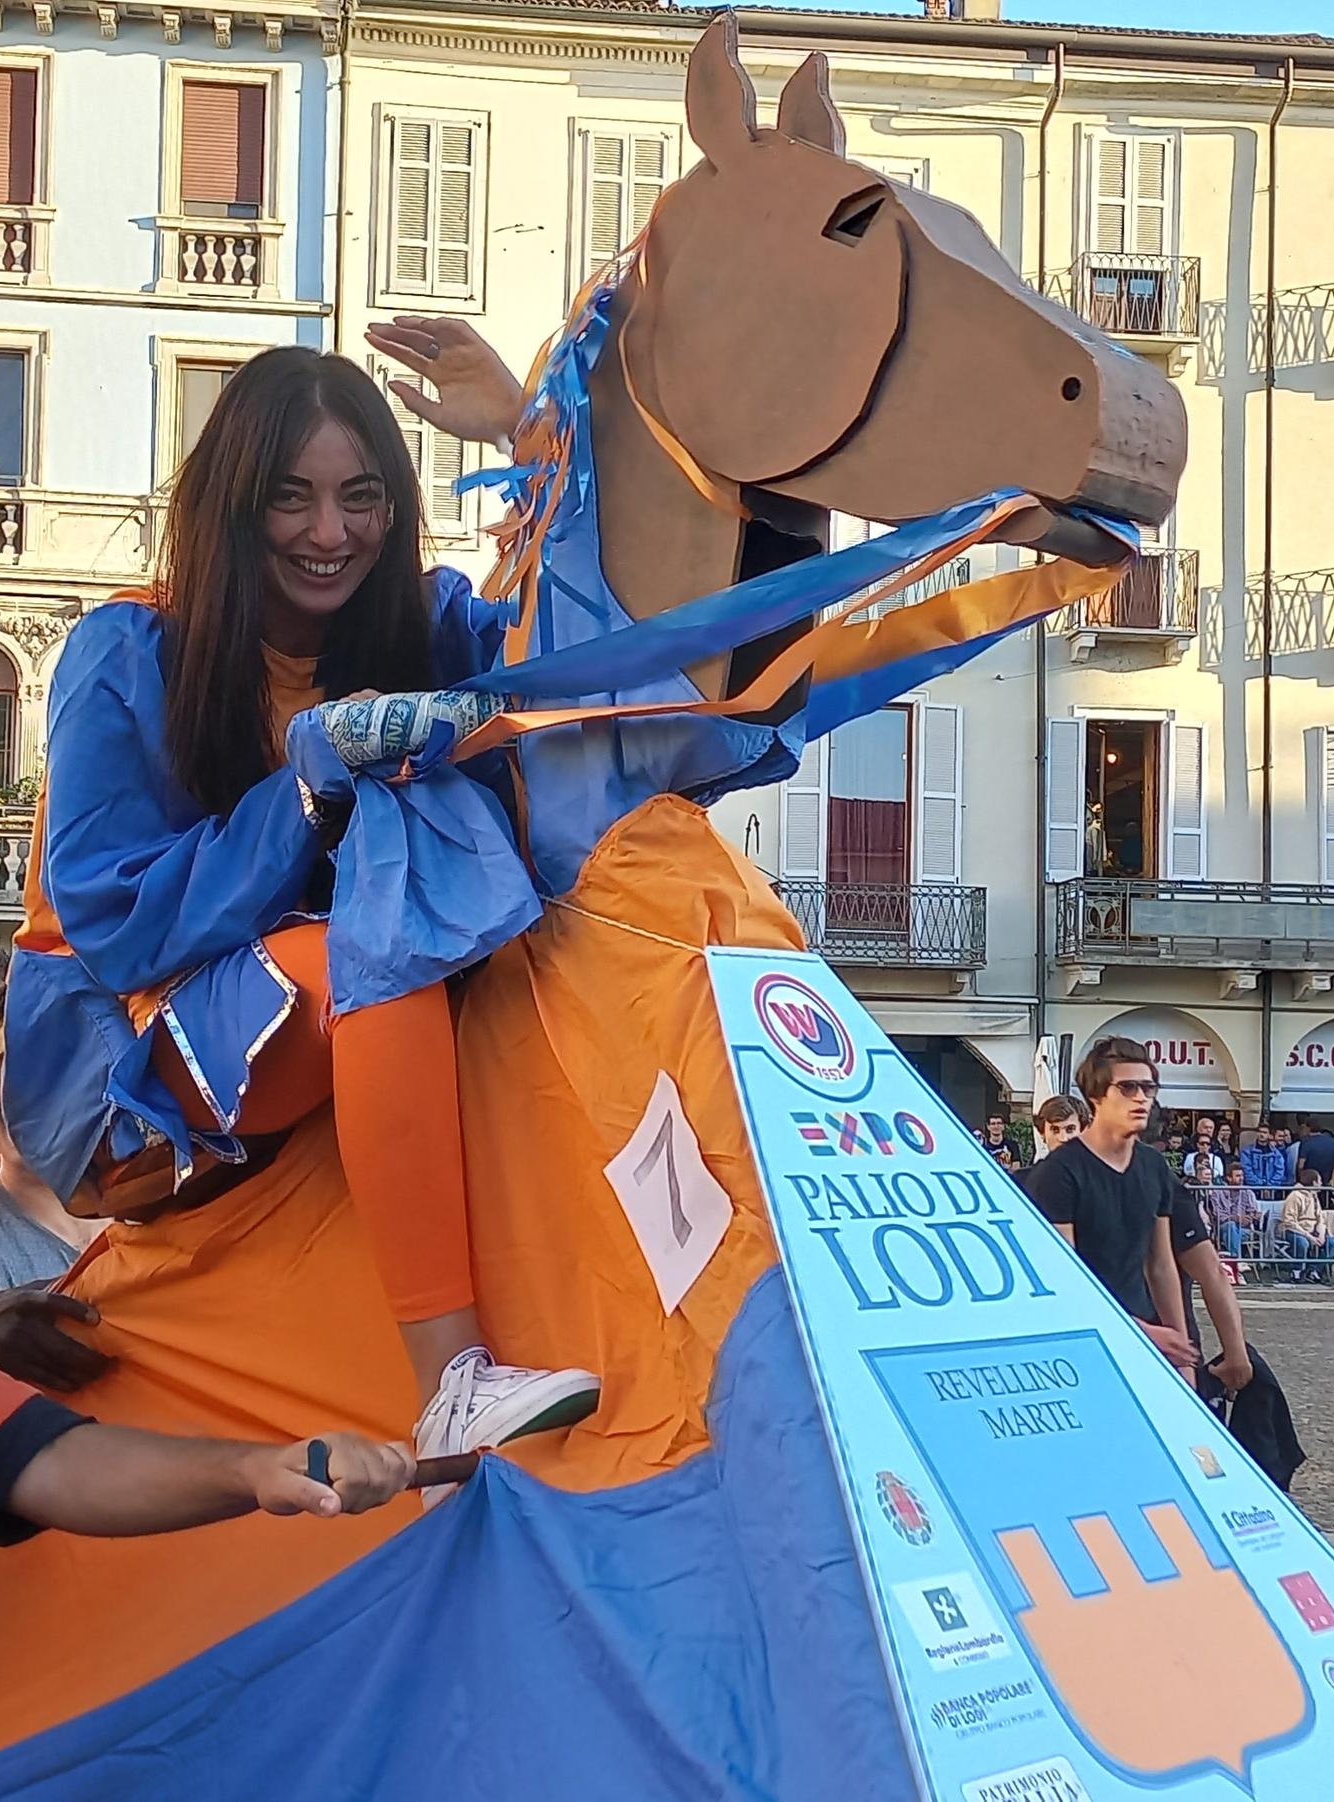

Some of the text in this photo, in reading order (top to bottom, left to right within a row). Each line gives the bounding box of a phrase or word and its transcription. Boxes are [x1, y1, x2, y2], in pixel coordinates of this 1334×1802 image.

[1145, 1039, 1215, 1066] O.U.T.
[788, 1110, 937, 1157] EXPO
[784, 1170, 1004, 1221] PALIO DI
[809, 1218, 1057, 1311] LODI
[924, 1357, 1080, 1402] REVELLINO
[977, 1399, 1084, 1440] MARTE
[977, 1679, 1034, 1706] POPOLARE
[978, 1768, 1063, 1802] PATRIMONIO
